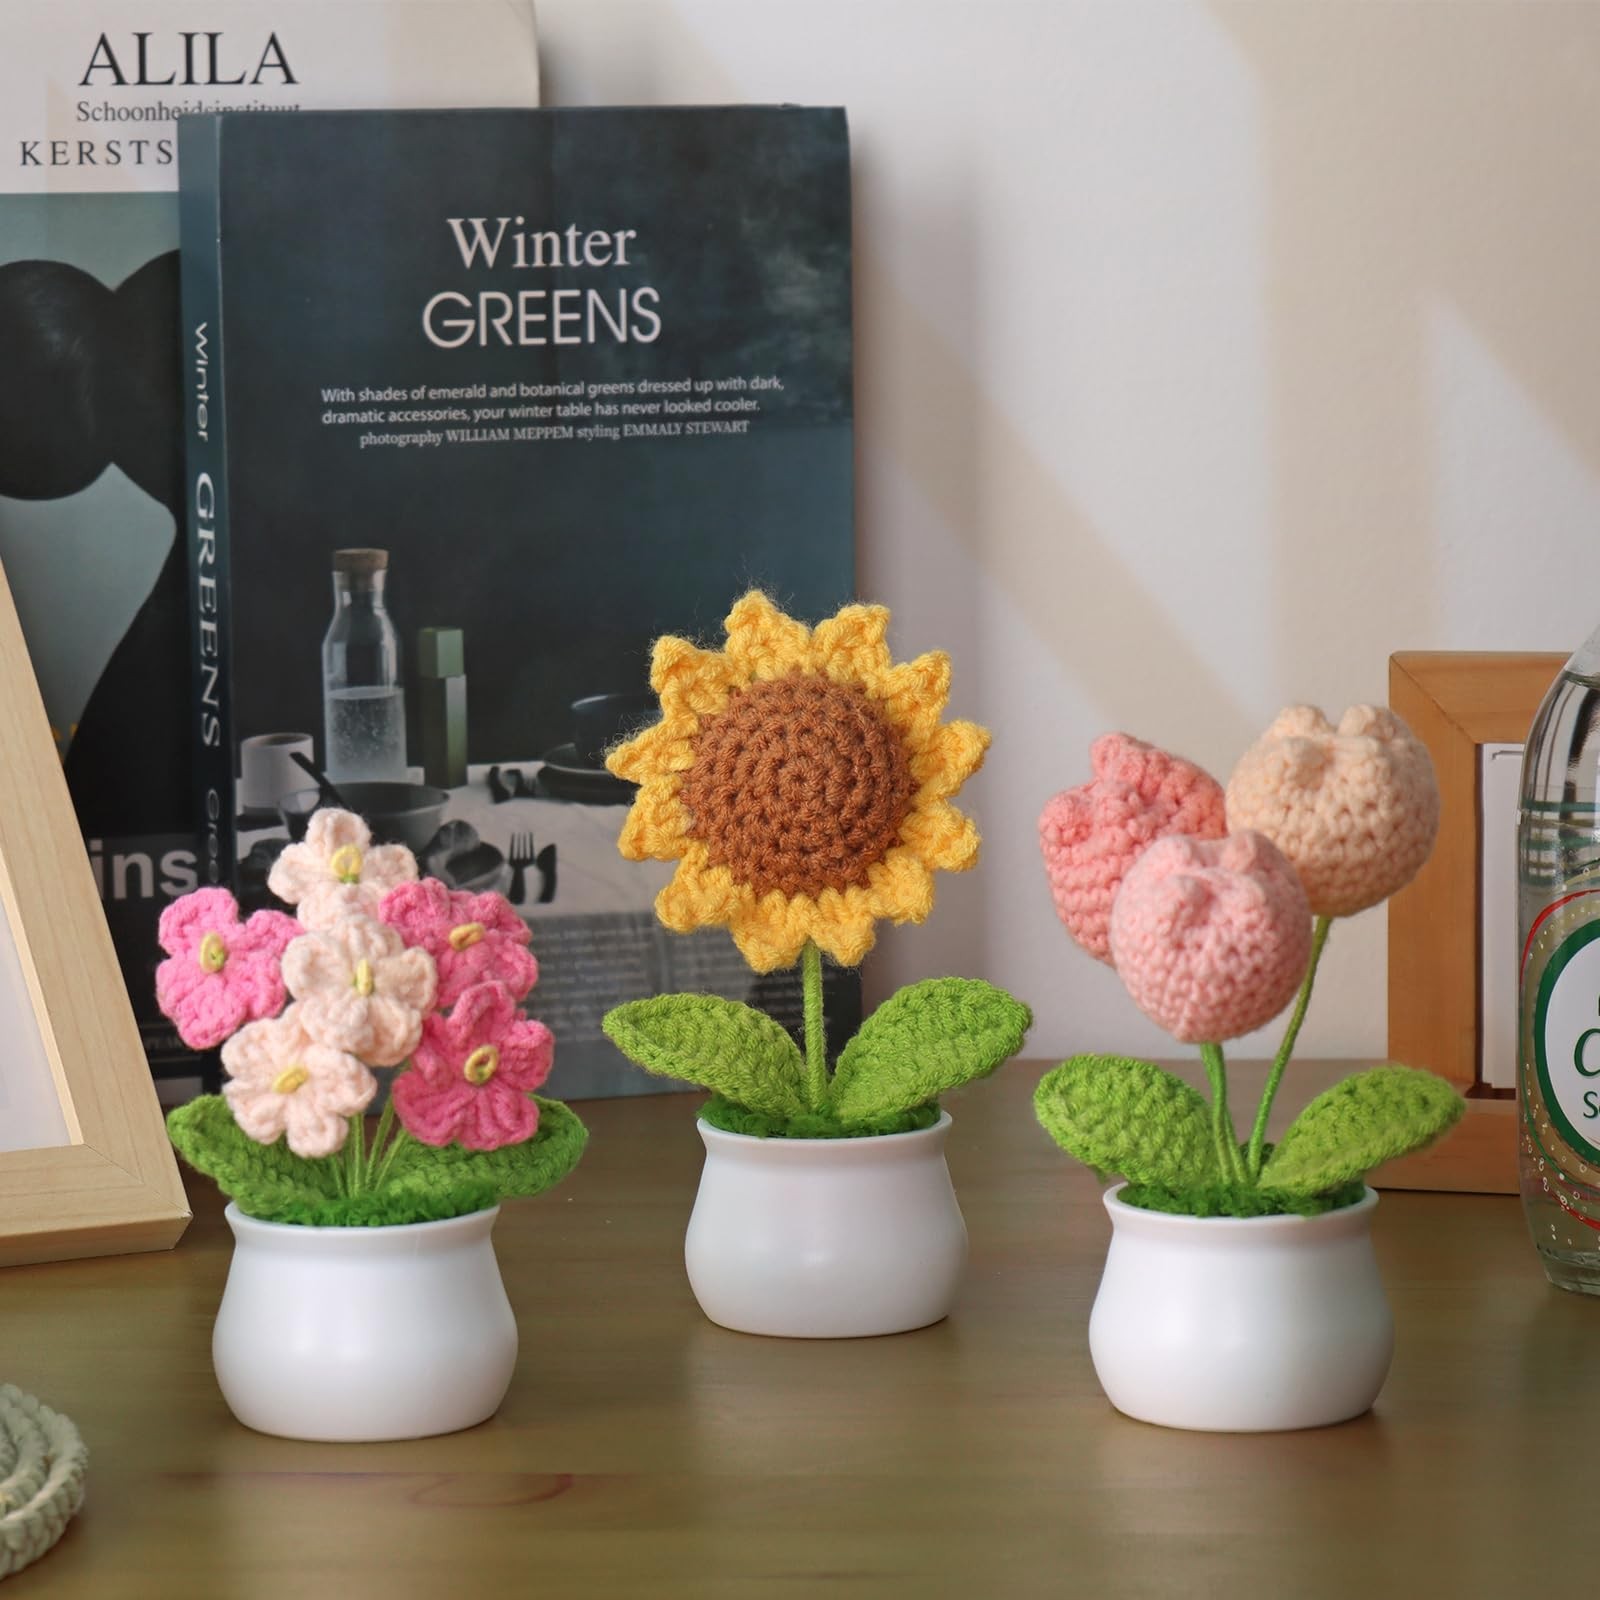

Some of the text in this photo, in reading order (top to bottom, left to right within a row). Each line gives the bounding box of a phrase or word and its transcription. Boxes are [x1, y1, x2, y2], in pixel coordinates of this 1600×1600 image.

[78, 31, 300, 87] ALILA
[20, 139, 174, 166] KERSTS
[446, 216, 637, 269] Winter
[423, 287, 662, 348] GREENS
[195, 322, 209, 442] Winter
[321, 375, 785, 403] With shades of emerald and botanical greens dressed up with dark,
[322, 398, 760, 424] dramatic accessories, your winter table has never looked cooler.
[360, 420, 750, 449] photography WILLIAM MEPPEM styling EMMALY STEWART
[196, 472, 220, 747] GREENS
